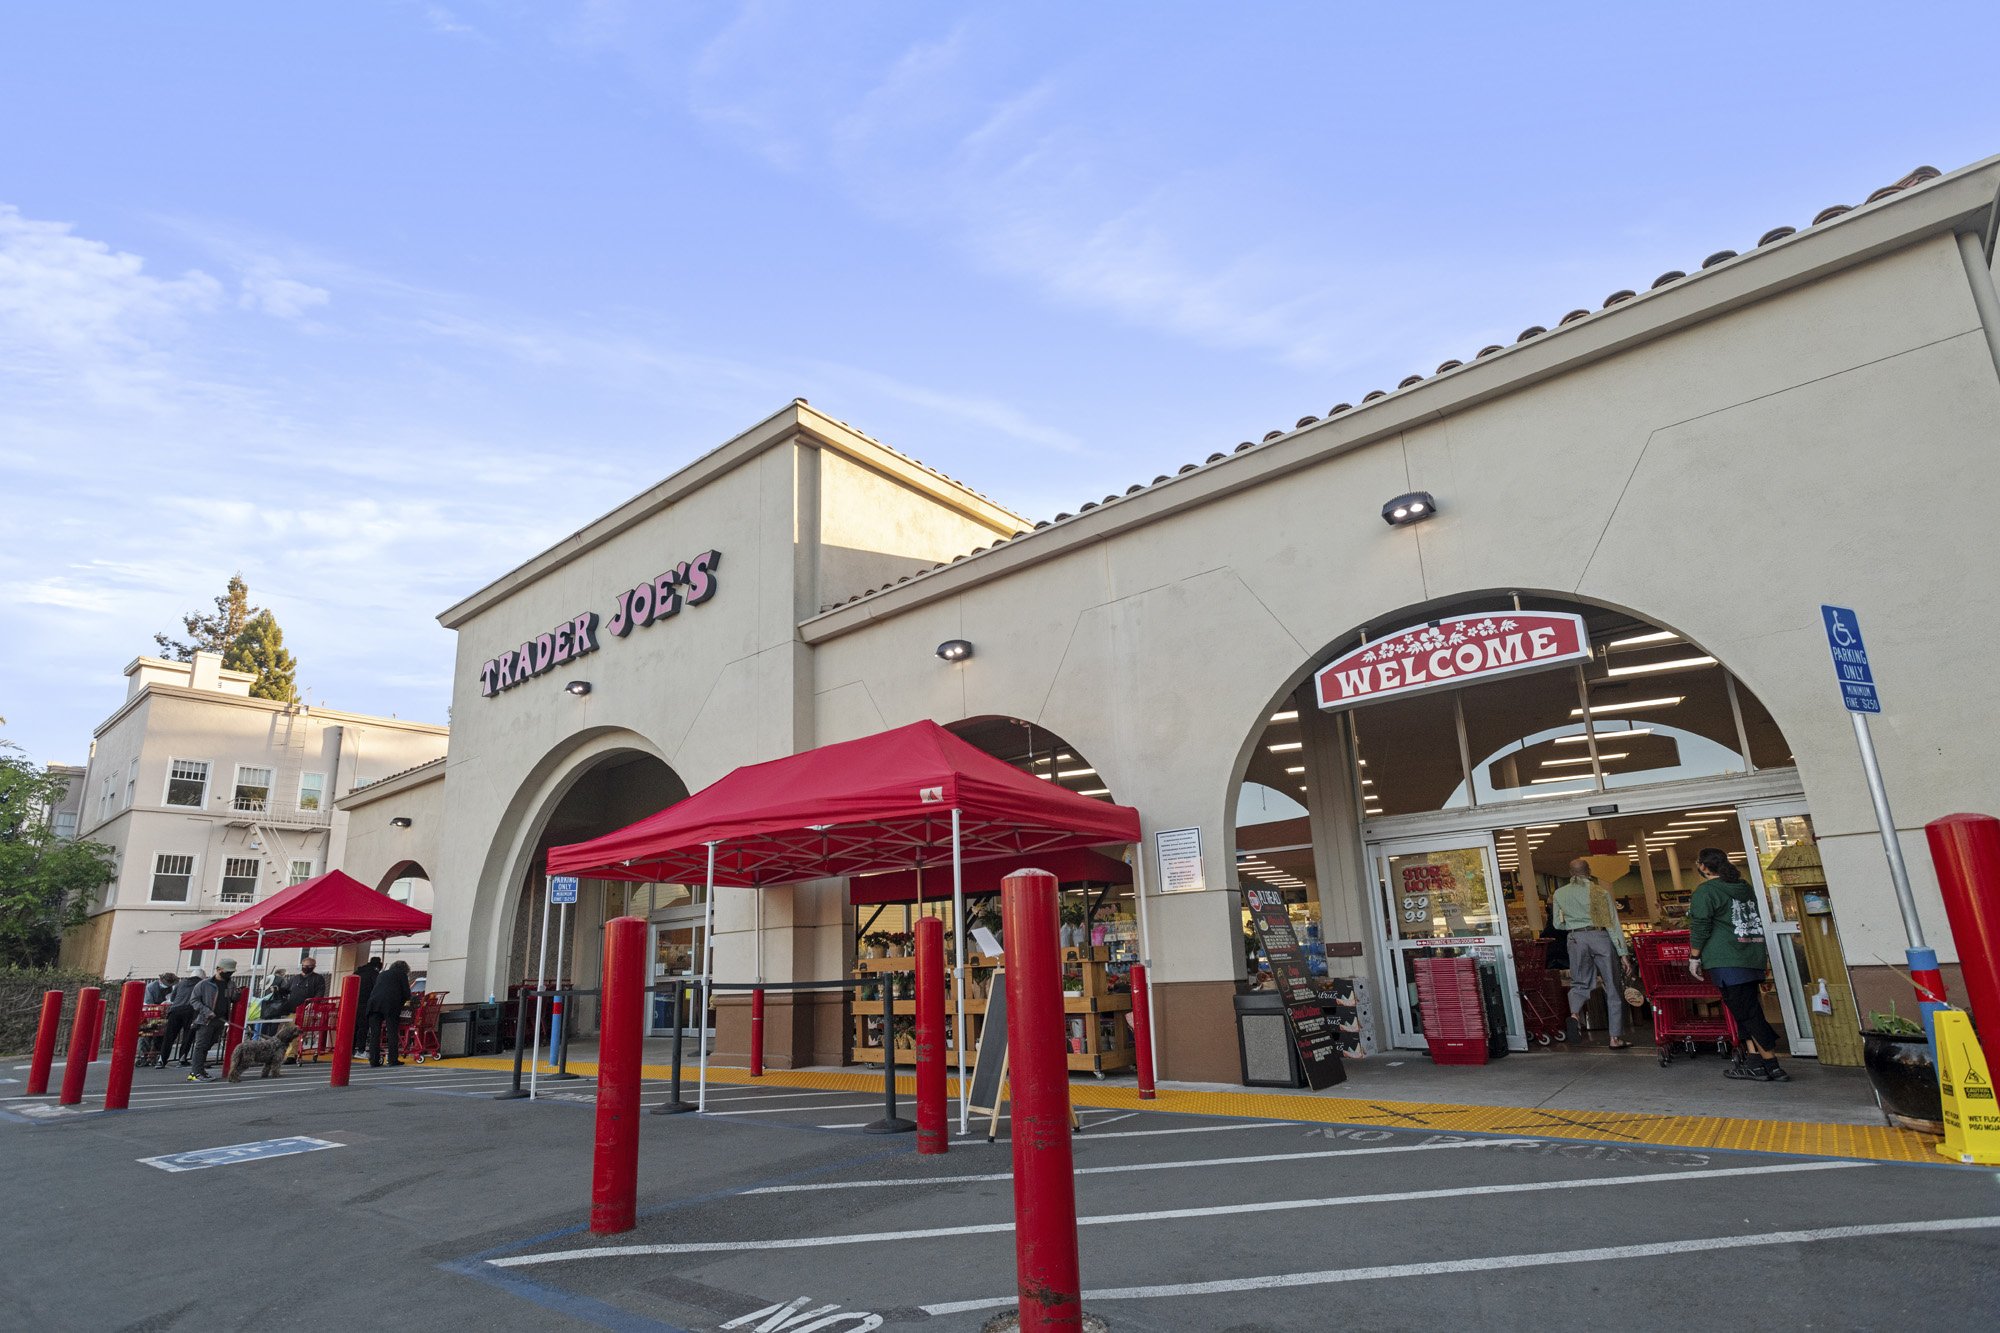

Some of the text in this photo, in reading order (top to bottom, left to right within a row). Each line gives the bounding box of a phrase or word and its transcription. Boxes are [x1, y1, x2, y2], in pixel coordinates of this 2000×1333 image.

[480, 549, 722, 697] TRADER JOE'S
[1334, 626, 1558, 698] WELCOME
[1833, 647, 1867, 664] PARKING
[1843, 664, 1864, 680] ONLY
[1846, 685, 1871, 696] MINIMUM
[1846, 697, 1859, 708] FINE
[1403, 864, 1450, 880] STORE
[1302, 1127, 1394, 1142] NO
[718, 1296, 884, 1333] NO
